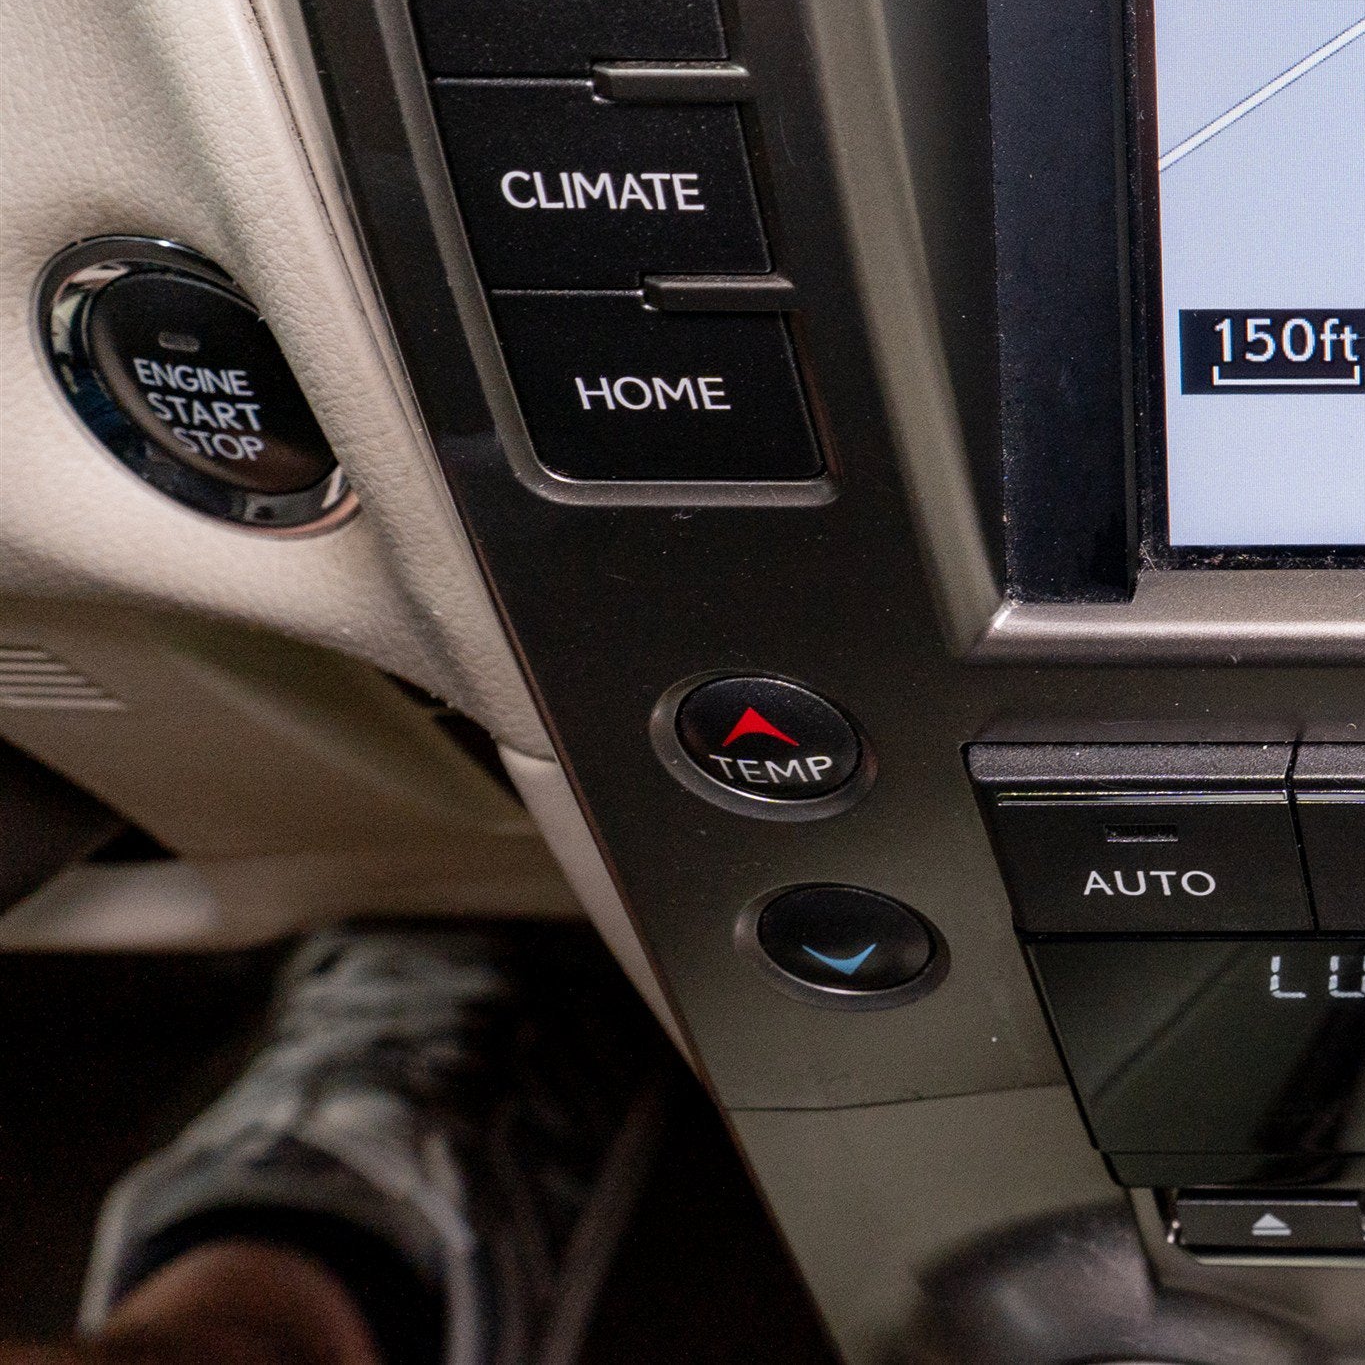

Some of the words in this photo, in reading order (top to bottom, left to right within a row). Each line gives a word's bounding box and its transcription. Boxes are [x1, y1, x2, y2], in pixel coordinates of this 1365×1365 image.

[501, 171, 704, 210] CLIMATE
[1215, 318, 1357, 362] 150ft
[135, 359, 253, 397] ENGINE
[575, 377, 731, 410] HOME
[148, 392, 260, 431] START
[173, 427, 264, 463] STOP
[709, 754, 833, 785] TEMP
[1084, 870, 1215, 896] AUTO
